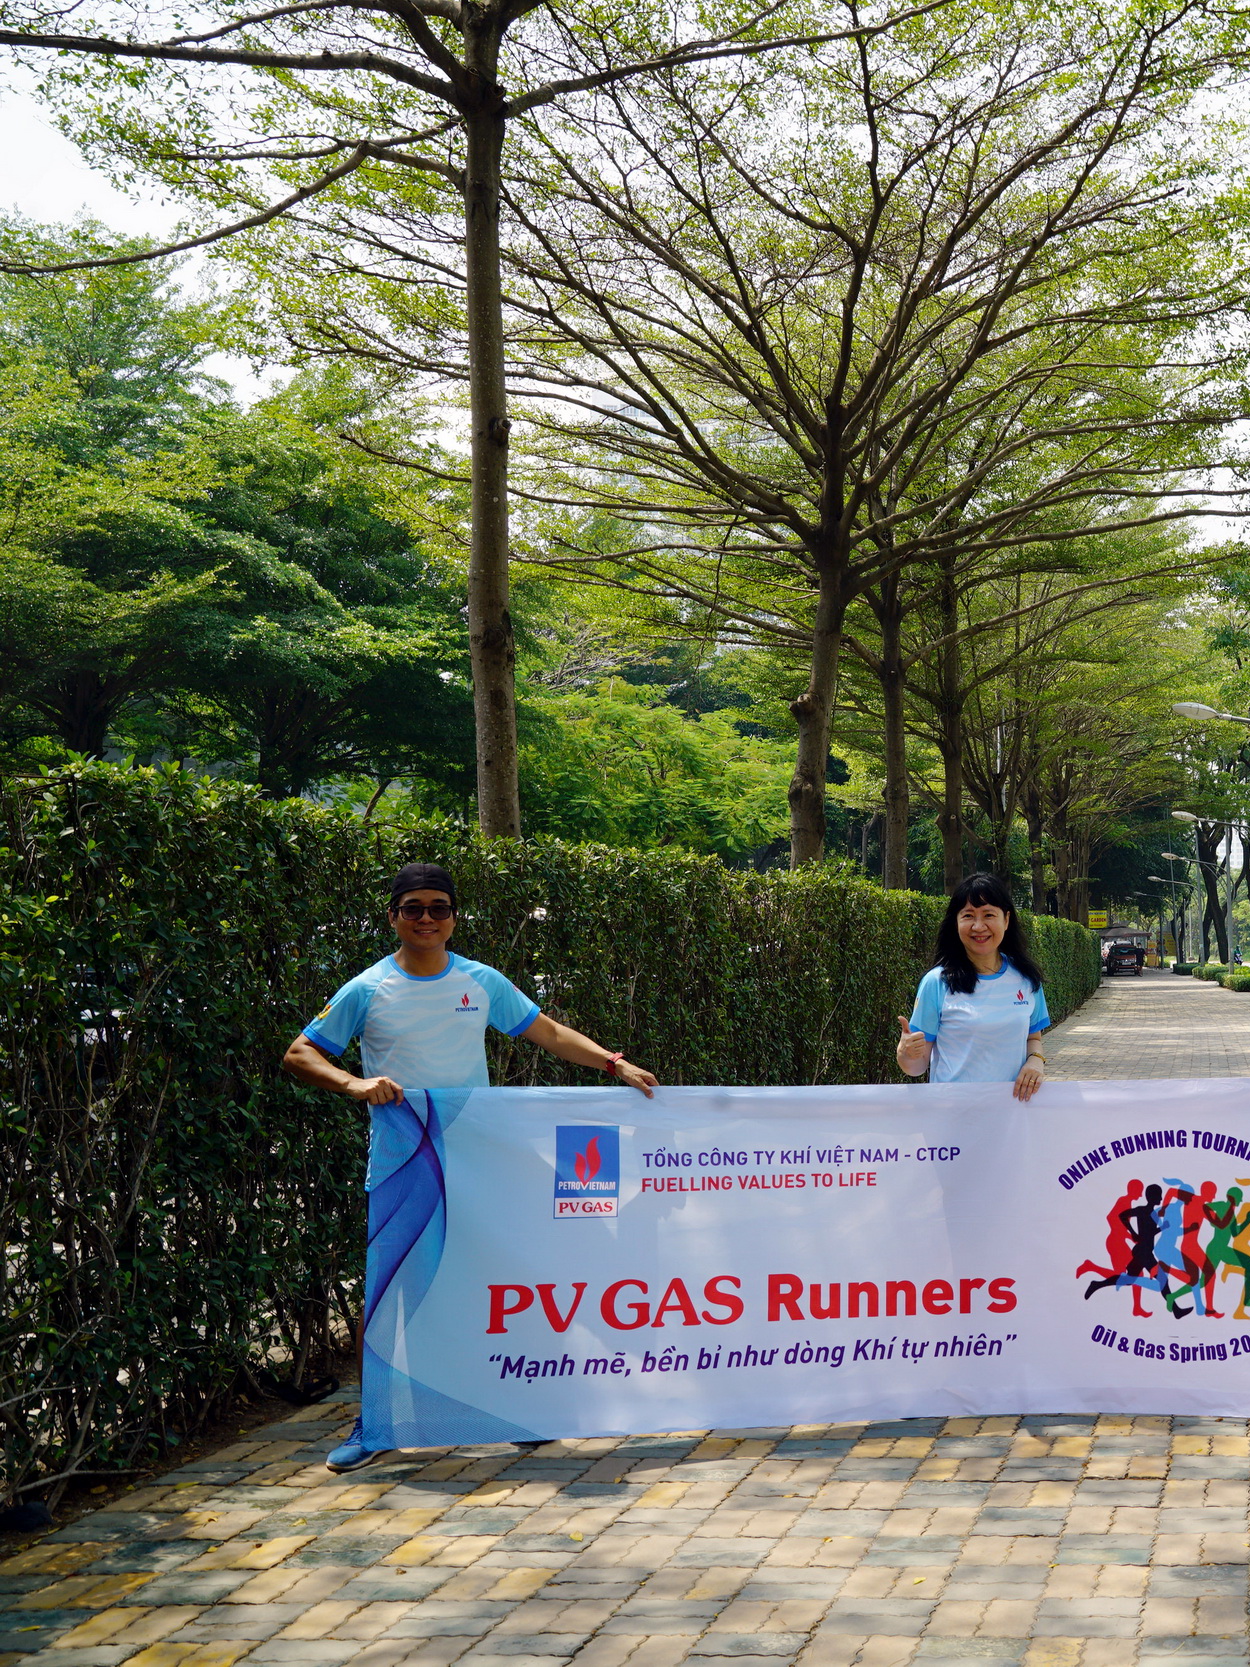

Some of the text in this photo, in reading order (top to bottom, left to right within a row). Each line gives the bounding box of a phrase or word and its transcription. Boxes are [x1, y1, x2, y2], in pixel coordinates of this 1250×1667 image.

[643, 1147, 693, 1168] TỔNG
[699, 1147, 748, 1167] CÔNG
[753, 1150, 776, 1165] TY
[780, 1145, 811, 1164] KHÍ
[815, 1146, 856, 1166] VIỆT
[859, 1148, 899, 1163] NAM
[916, 1146, 961, 1162] CTCP
[1058, 1145, 1112, 1190] ONLINE
[1110, 1129, 1187, 1159] RUNNING
[558, 1180, 616, 1193] PETROVIETNAM
[641, 1172, 877, 1193] FUELLING VALUES TO LIFE
[558, 1200, 613, 1214] PV GAS
[485, 1272, 1018, 1335] PV GAS Runners
[582, 1348, 631, 1379] mẽ,
[641, 1345, 690, 1374] bền
[697, 1344, 720, 1370] bỉ
[727, 1346, 779, 1368] như
[784, 1340, 845, 1368] dòng
[853, 1335, 896, 1361] Khí
[900, 1340, 930, 1365] tự
[1091, 1324, 1118, 1349] Oil
[1117, 1336, 1130, 1354] &
[1133, 1337, 1166, 1360] Gas
[1169, 1342, 1228, 1364] Spring
